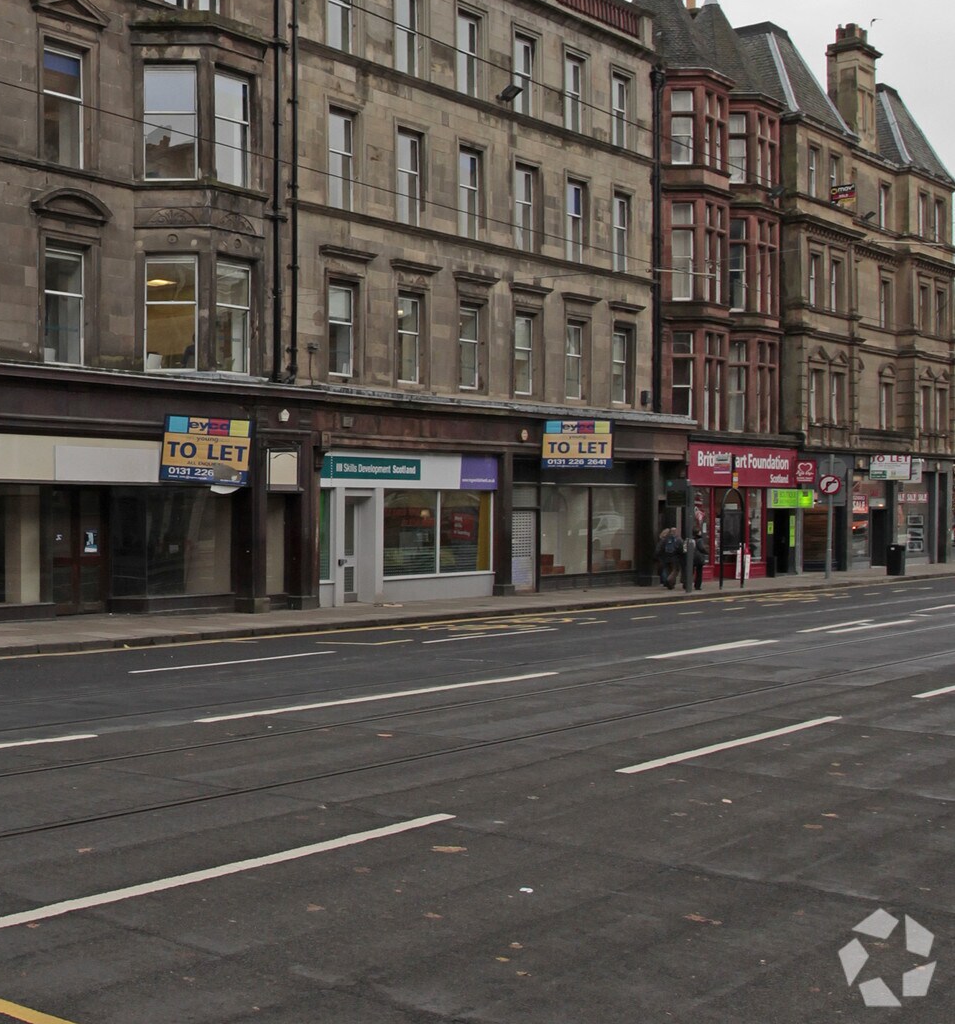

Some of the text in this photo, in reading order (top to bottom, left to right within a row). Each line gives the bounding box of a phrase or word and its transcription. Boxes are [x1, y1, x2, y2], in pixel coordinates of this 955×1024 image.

[167, 441, 248, 462] TO LET
[548, 442, 608, 454] TO LET
[748, 453, 789, 470] Foundation
[890, 455, 909, 463] LET
[168, 466, 191, 475] 0131
[194, 468, 214, 477] 226
[343, 463, 417, 475] Skills Development Scotland
[769, 474, 789, 484] Scotland
